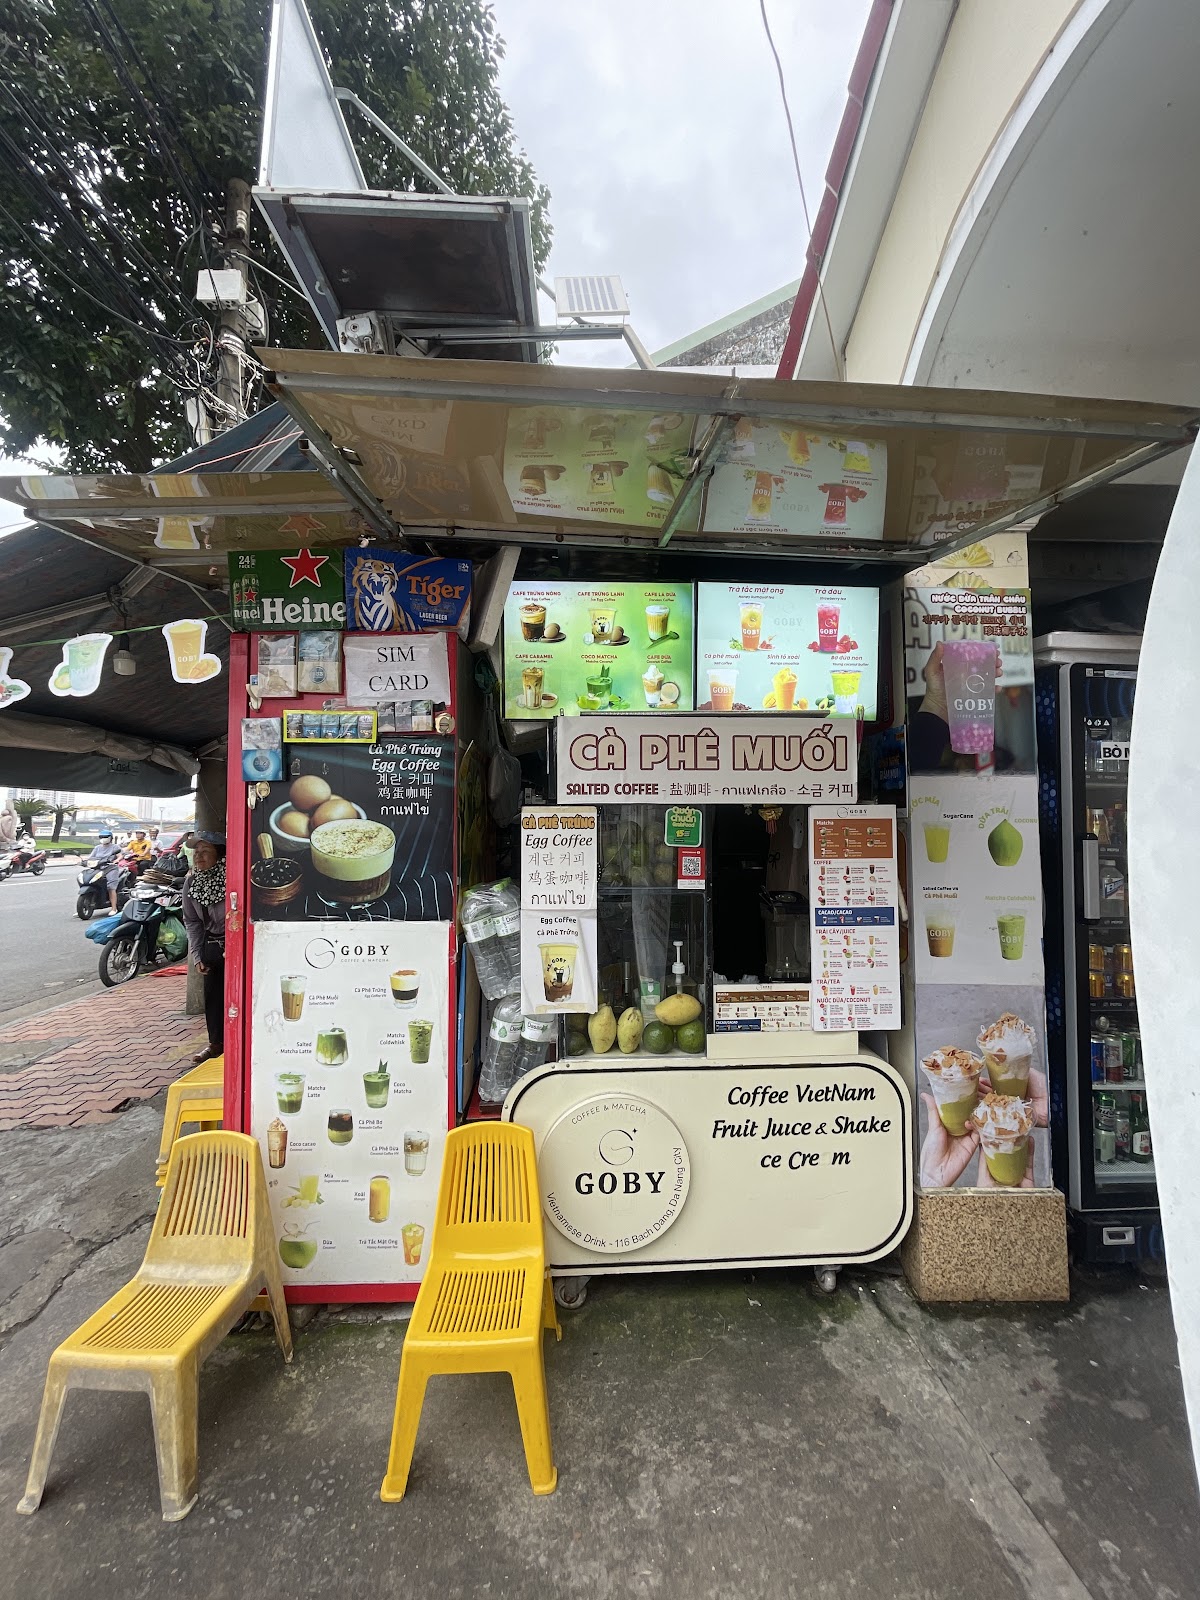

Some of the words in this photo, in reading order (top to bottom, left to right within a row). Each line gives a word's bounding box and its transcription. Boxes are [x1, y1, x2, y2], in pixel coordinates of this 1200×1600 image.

[238, 555, 251, 565] 24
[406, 576, 465, 606] Tiger
[954, 604, 995, 614] COCONUT
[996, 606, 1027, 614] BUBBLE
[377, 646, 415, 663] SIM
[368, 675, 429, 692] CARD
[954, 699, 994, 711] GOBY
[368, 743, 384, 755] Cà
[385, 743, 407, 755] Phê
[569, 726, 627, 771] CÀ
[639, 727, 719, 771] PHÊ
[732, 724, 848, 772] MUỐI
[371, 758, 396, 772] Egg
[400, 758, 440, 772] Coffee
[376, 773, 402, 785] 계란
[408, 773, 434, 785] 커피
[378, 786, 432, 799] 鸡蛋咖啡
[566, 783, 610, 796] SALTED
[614, 783, 659, 796] COFFEE
[669, 782, 711, 797] 盐咖啡
[796, 783, 824, 798] 소금
[828, 783, 854, 798] 커피
[522, 814, 537, 829] CÀ
[538, 814, 559, 829] PHÊ
[560, 813, 595, 830] TRỨNG
[525, 834, 548, 849] Egg
[552, 833, 593, 848] Coffee
[528, 851, 555, 867] 계란
[559, 851, 585, 867] 커피
[528, 870, 589, 886] 鸡蛋咖啡
[540, 917, 553, 925] Egg
[554, 916, 576, 924] Coffee
[929, 929, 952, 937] GOBY
[341, 945, 390, 956] GOBY
[727, 1085, 789, 1107] Coffee
[571, 1105, 600, 1125] COFFEE
[612, 1103, 647, 1115] MATCHA
[712, 1119, 758, 1138] Fruit
[815, 1123, 827, 1134] &
[832, 1116, 891, 1134] Shake
[673, 1148, 683, 1165] City
[575, 1172, 665, 1195] GOBY
[674, 1167, 685, 1191] Nang
[669, 1194, 680, 1206] Da
[547, 1192, 582, 1238] Vietnamese
[653, 1207, 676, 1231] Dang,
[584, 1234, 606, 1247] Drink
[615, 1238, 629, 1248] 116
[632, 1229, 654, 1244] Bach
